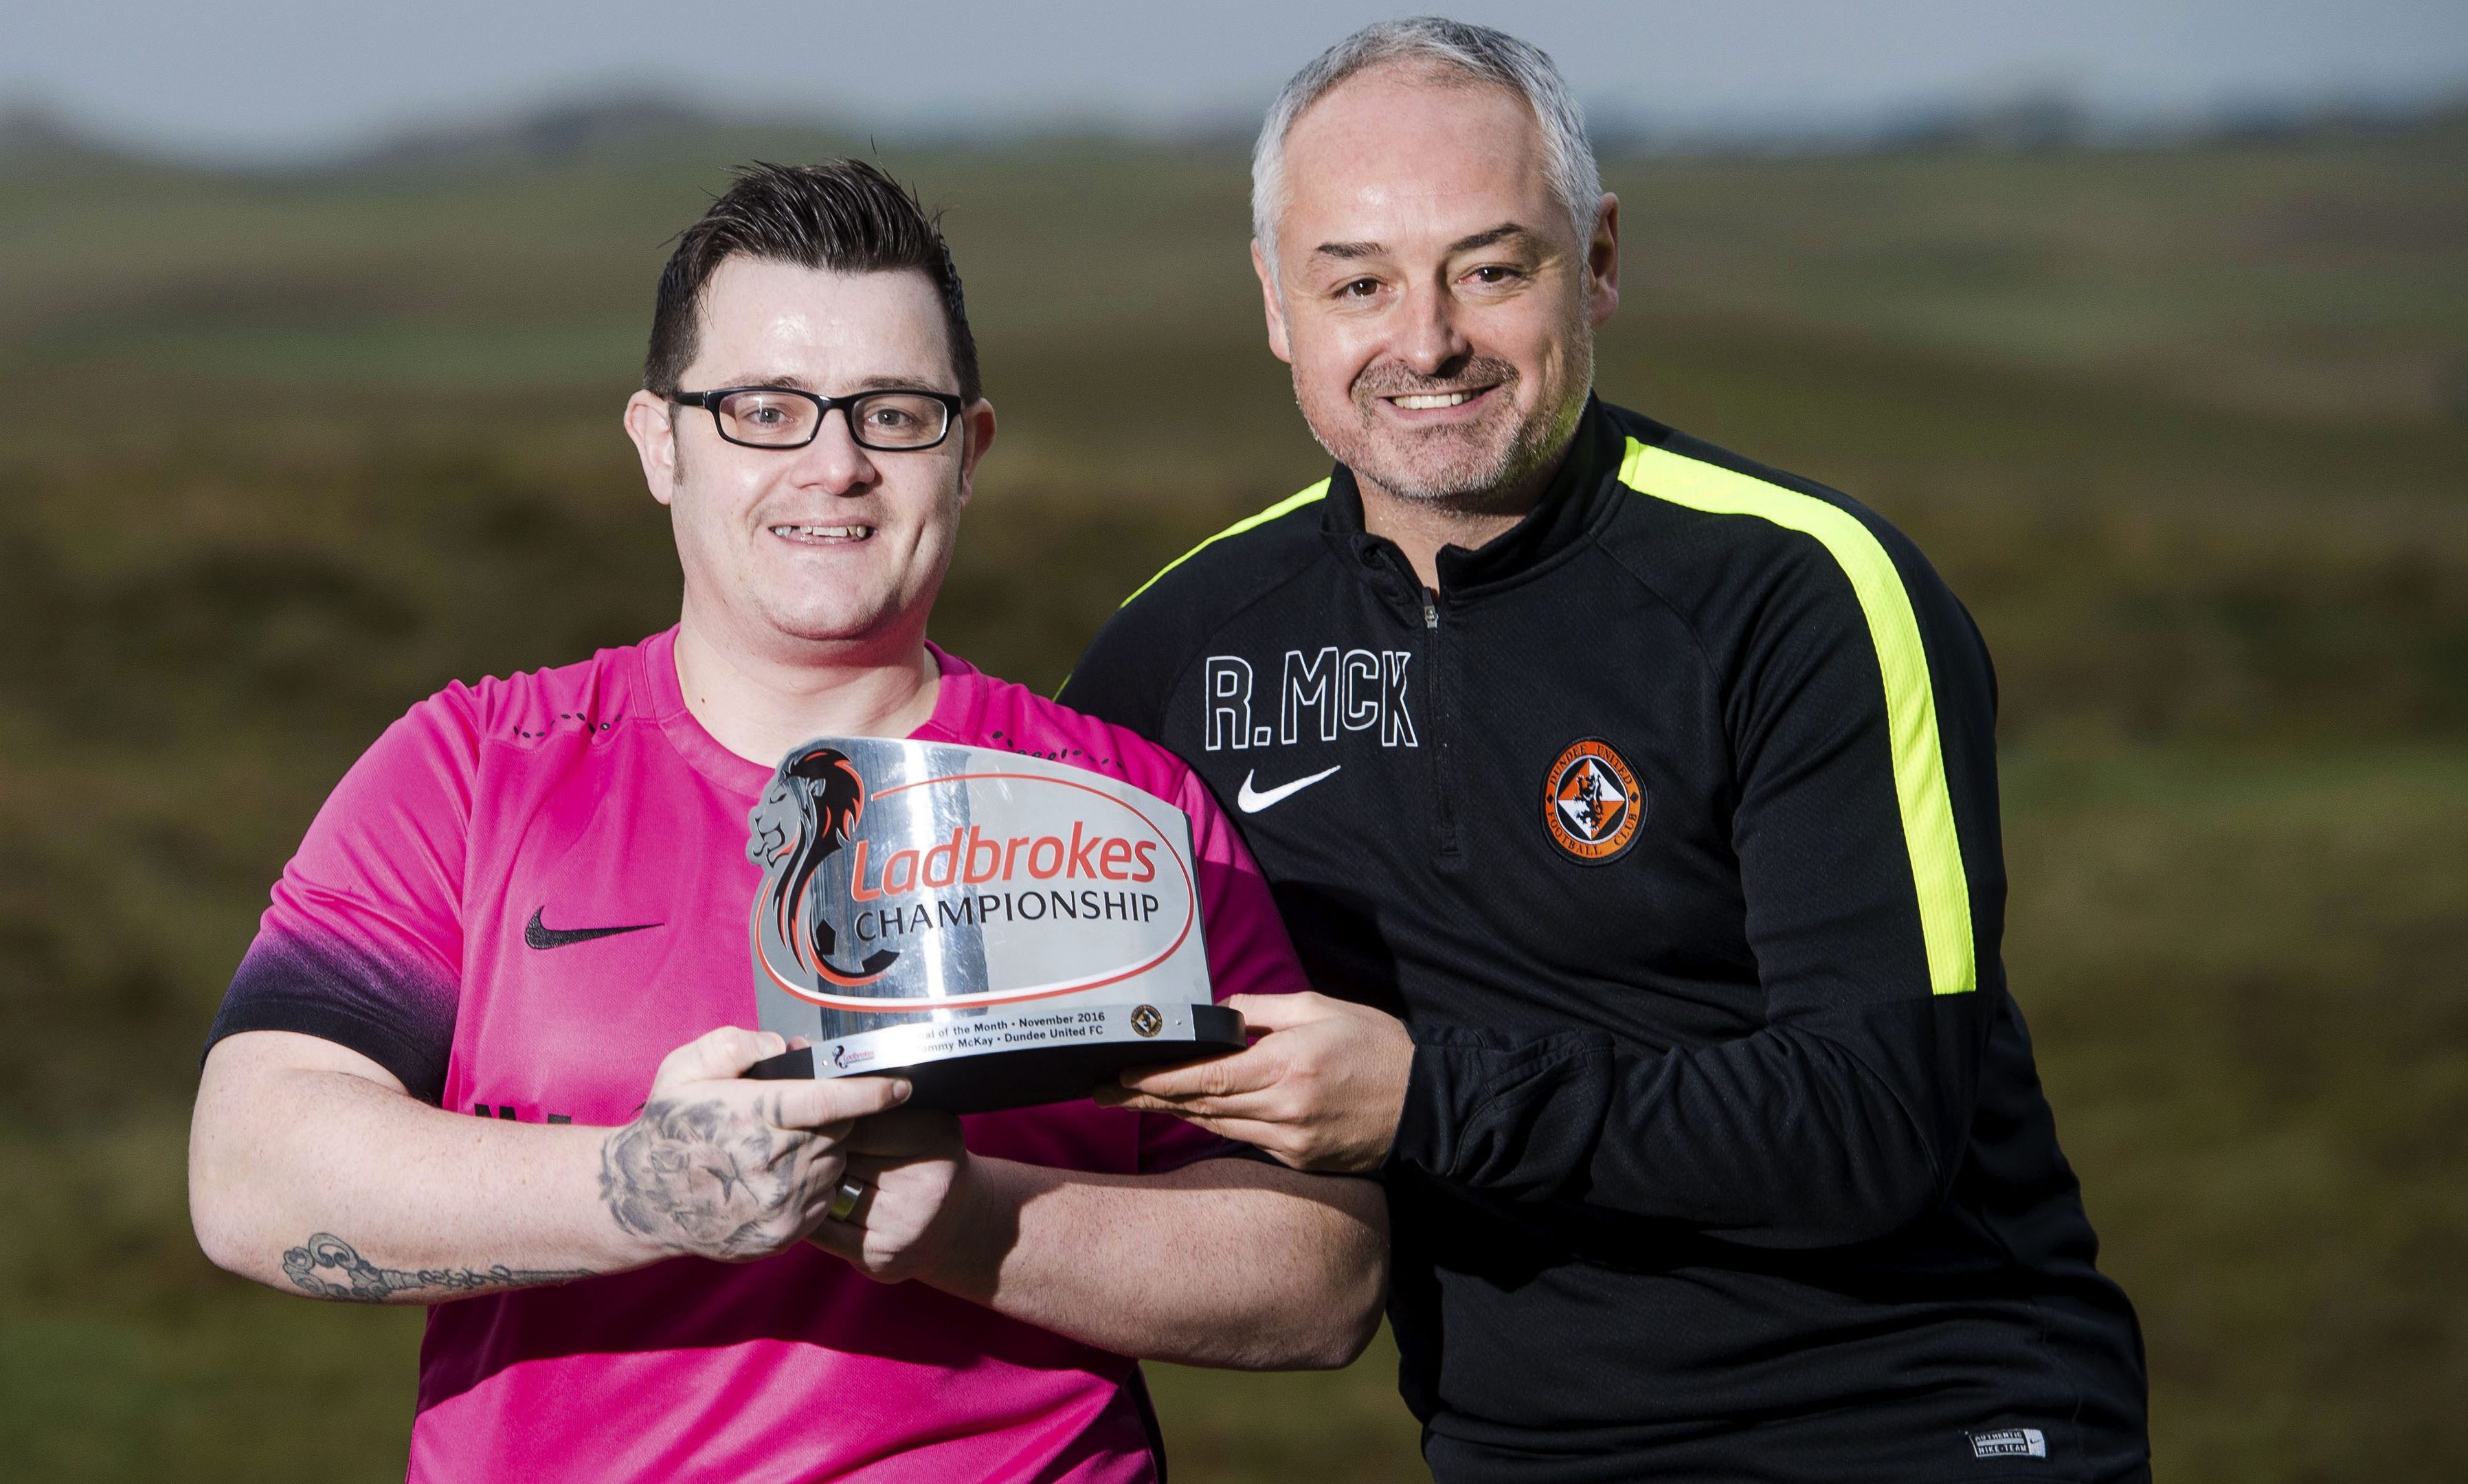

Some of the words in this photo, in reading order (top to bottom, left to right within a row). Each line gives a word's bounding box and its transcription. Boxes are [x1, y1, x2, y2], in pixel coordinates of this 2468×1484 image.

[1549, 744, 1586, 787] DUNDEE
[1596, 744, 1633, 785] UNITED
[1547, 811, 1602, 856] FOOTBALL
[1613, 813, 1637, 846] CLUB
[851, 820, 1157, 903] Ladbrokes
[855, 890, 1159, 943] CHAMPIONSHIP
[939, 1027, 949, 1037] of
[954, 1026, 970, 1035] the
[974, 1020, 1008, 1032] Month
[1019, 1015, 1074, 1028] November
[1077, 1011, 1106, 1023] 2016
[958, 1037, 994, 1048] McKay
[1005, 1031, 1046, 1042] Dundee
[1050, 1026, 1086, 1038] United
[1089, 1025, 1103, 1035] FC
[1975, 1431, 2023, 1442] AUTHENTIC
